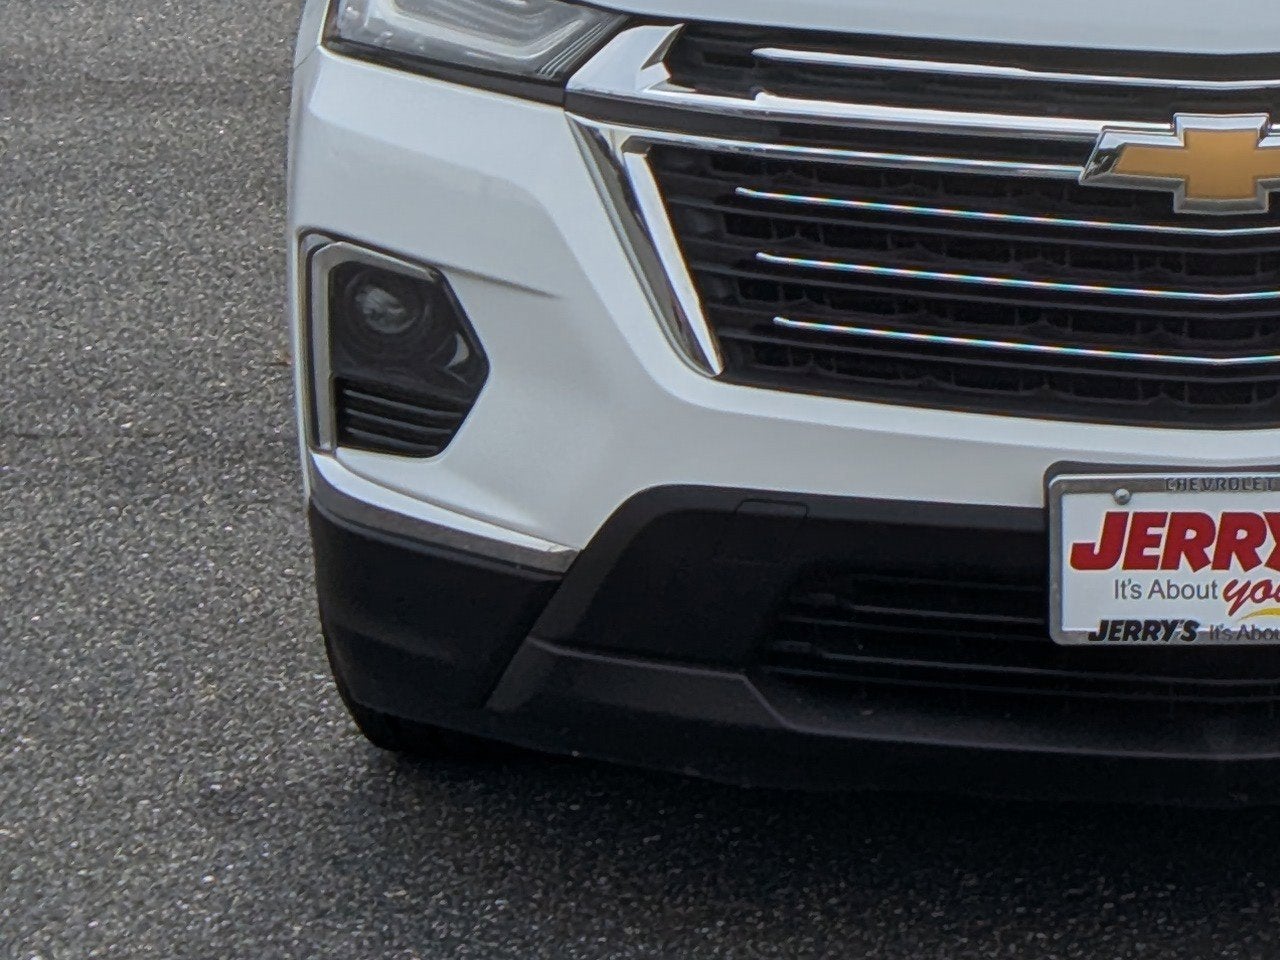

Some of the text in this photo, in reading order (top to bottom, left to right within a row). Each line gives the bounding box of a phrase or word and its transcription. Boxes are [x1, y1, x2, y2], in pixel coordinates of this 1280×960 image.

[1164, 477, 1274, 491] CHEVROLET
[1114, 578, 1143, 600] It's
[1149, 579, 1219, 600] About
[1088, 619, 1200, 642] JERRY'S
[1209, 623, 1234, 640] It's
